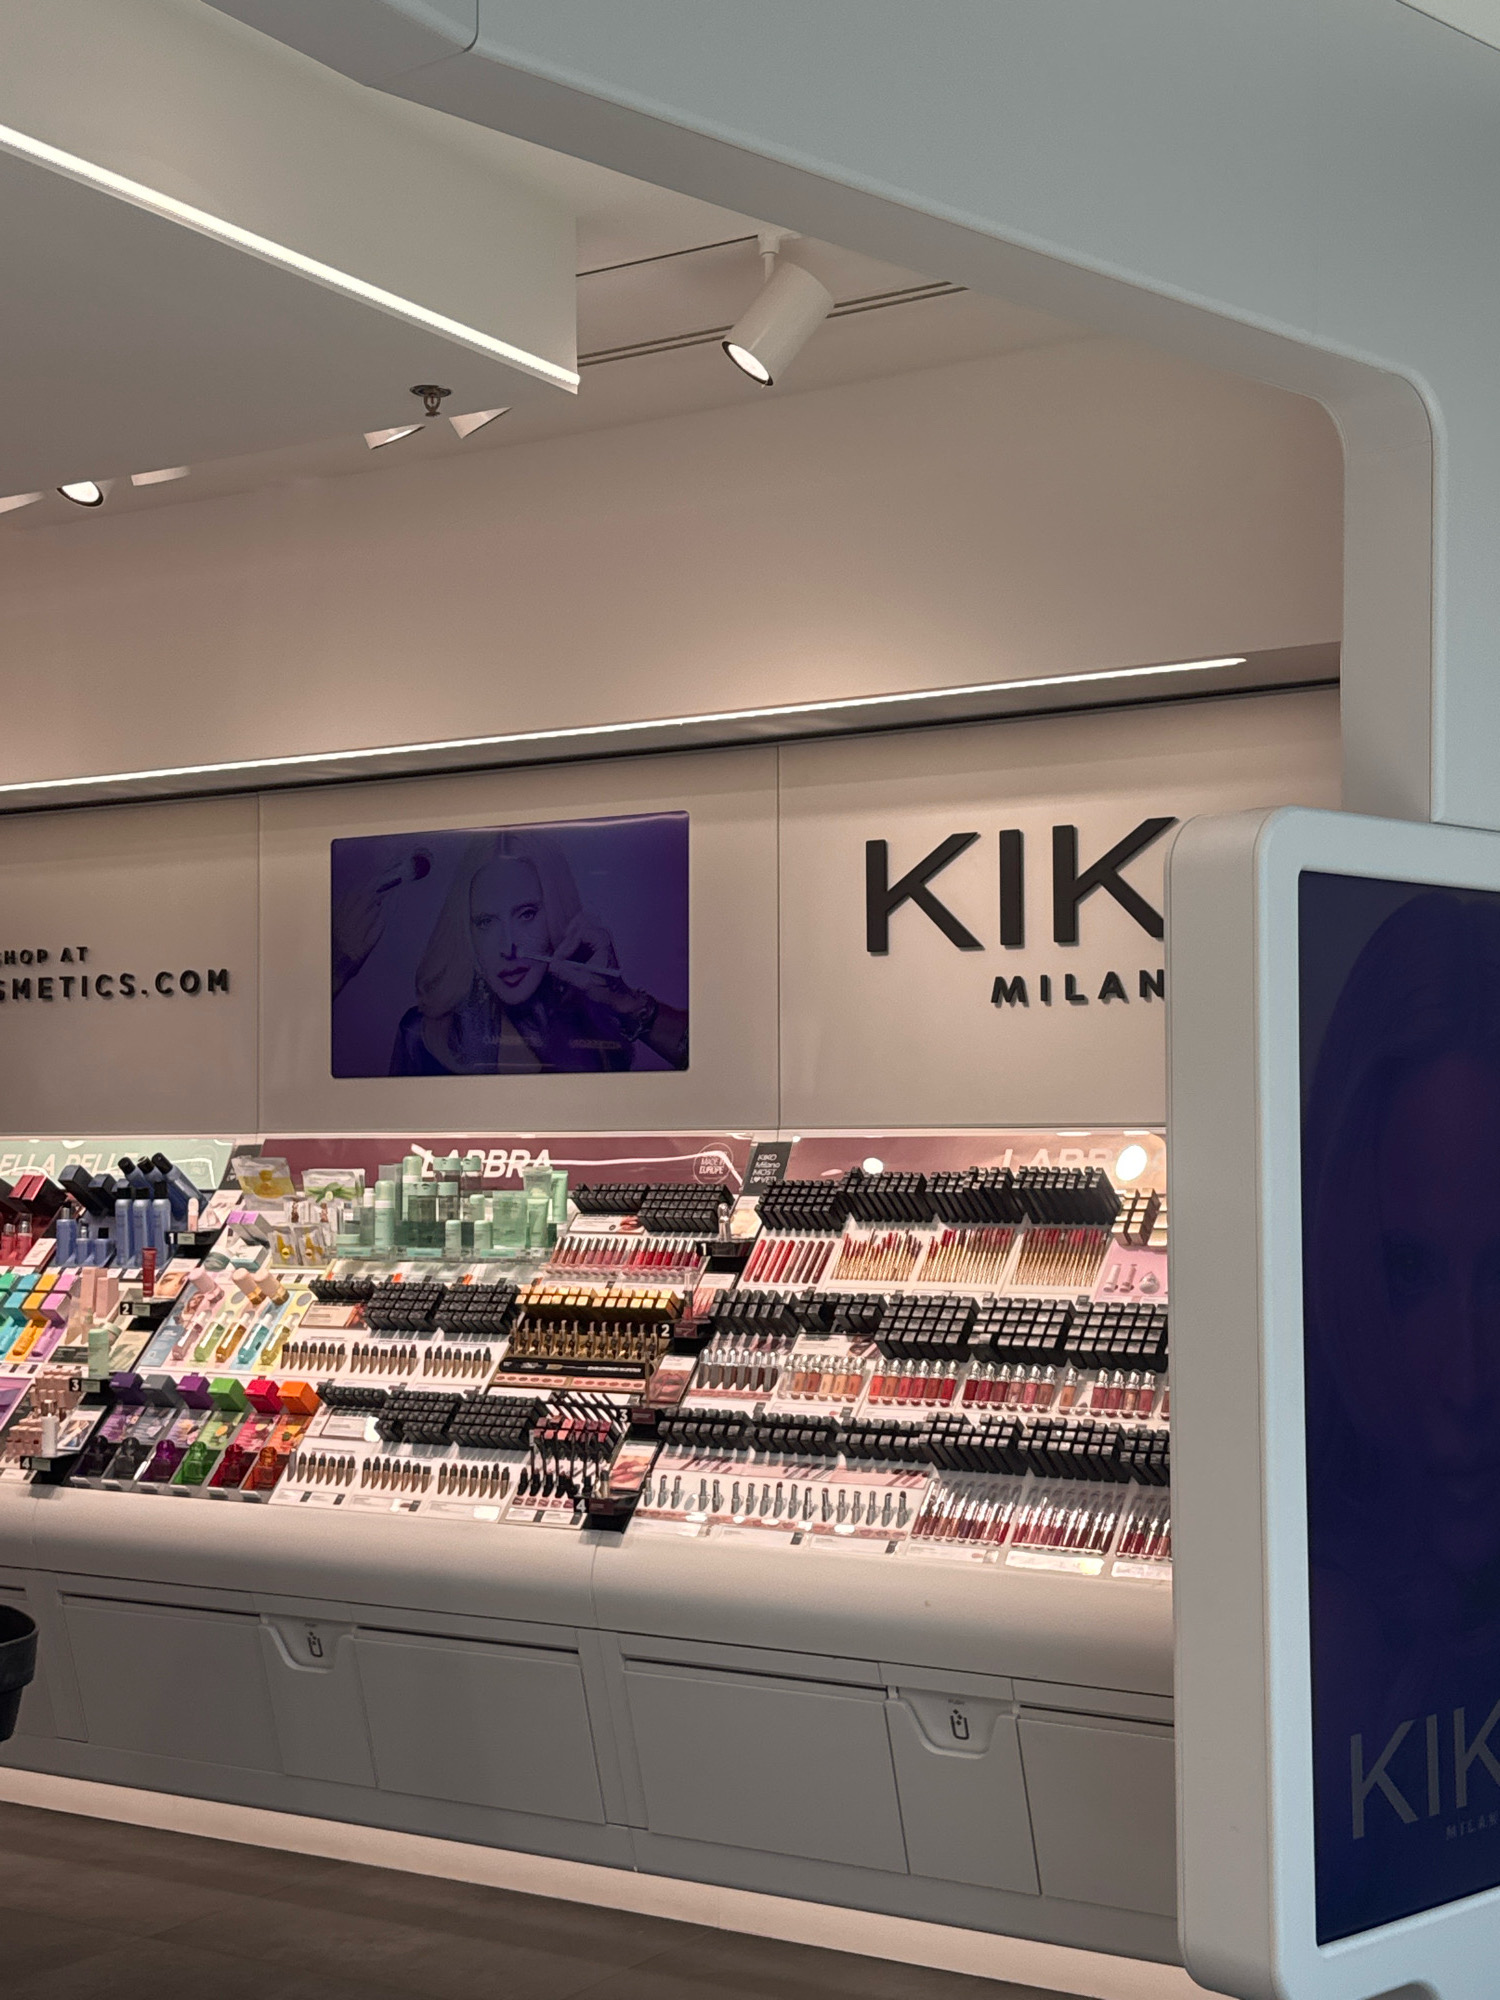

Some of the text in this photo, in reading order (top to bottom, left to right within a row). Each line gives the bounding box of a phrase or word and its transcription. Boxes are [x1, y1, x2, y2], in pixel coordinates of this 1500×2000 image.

[866, 816, 1178, 954] KIK
[0, 946, 88, 966] HOP AT
[991, 968, 1165, 1004] MILAN
[122, 1304, 129, 1315] 2
[661, 1324, 670, 1338] 2
[71, 1379, 80, 1391] 3
[619, 1409, 628, 1423] 3
[22, 1457, 30, 1469] 4
[577, 1499, 587, 1513] 4
[1351, 1699, 1500, 1840] KIK
